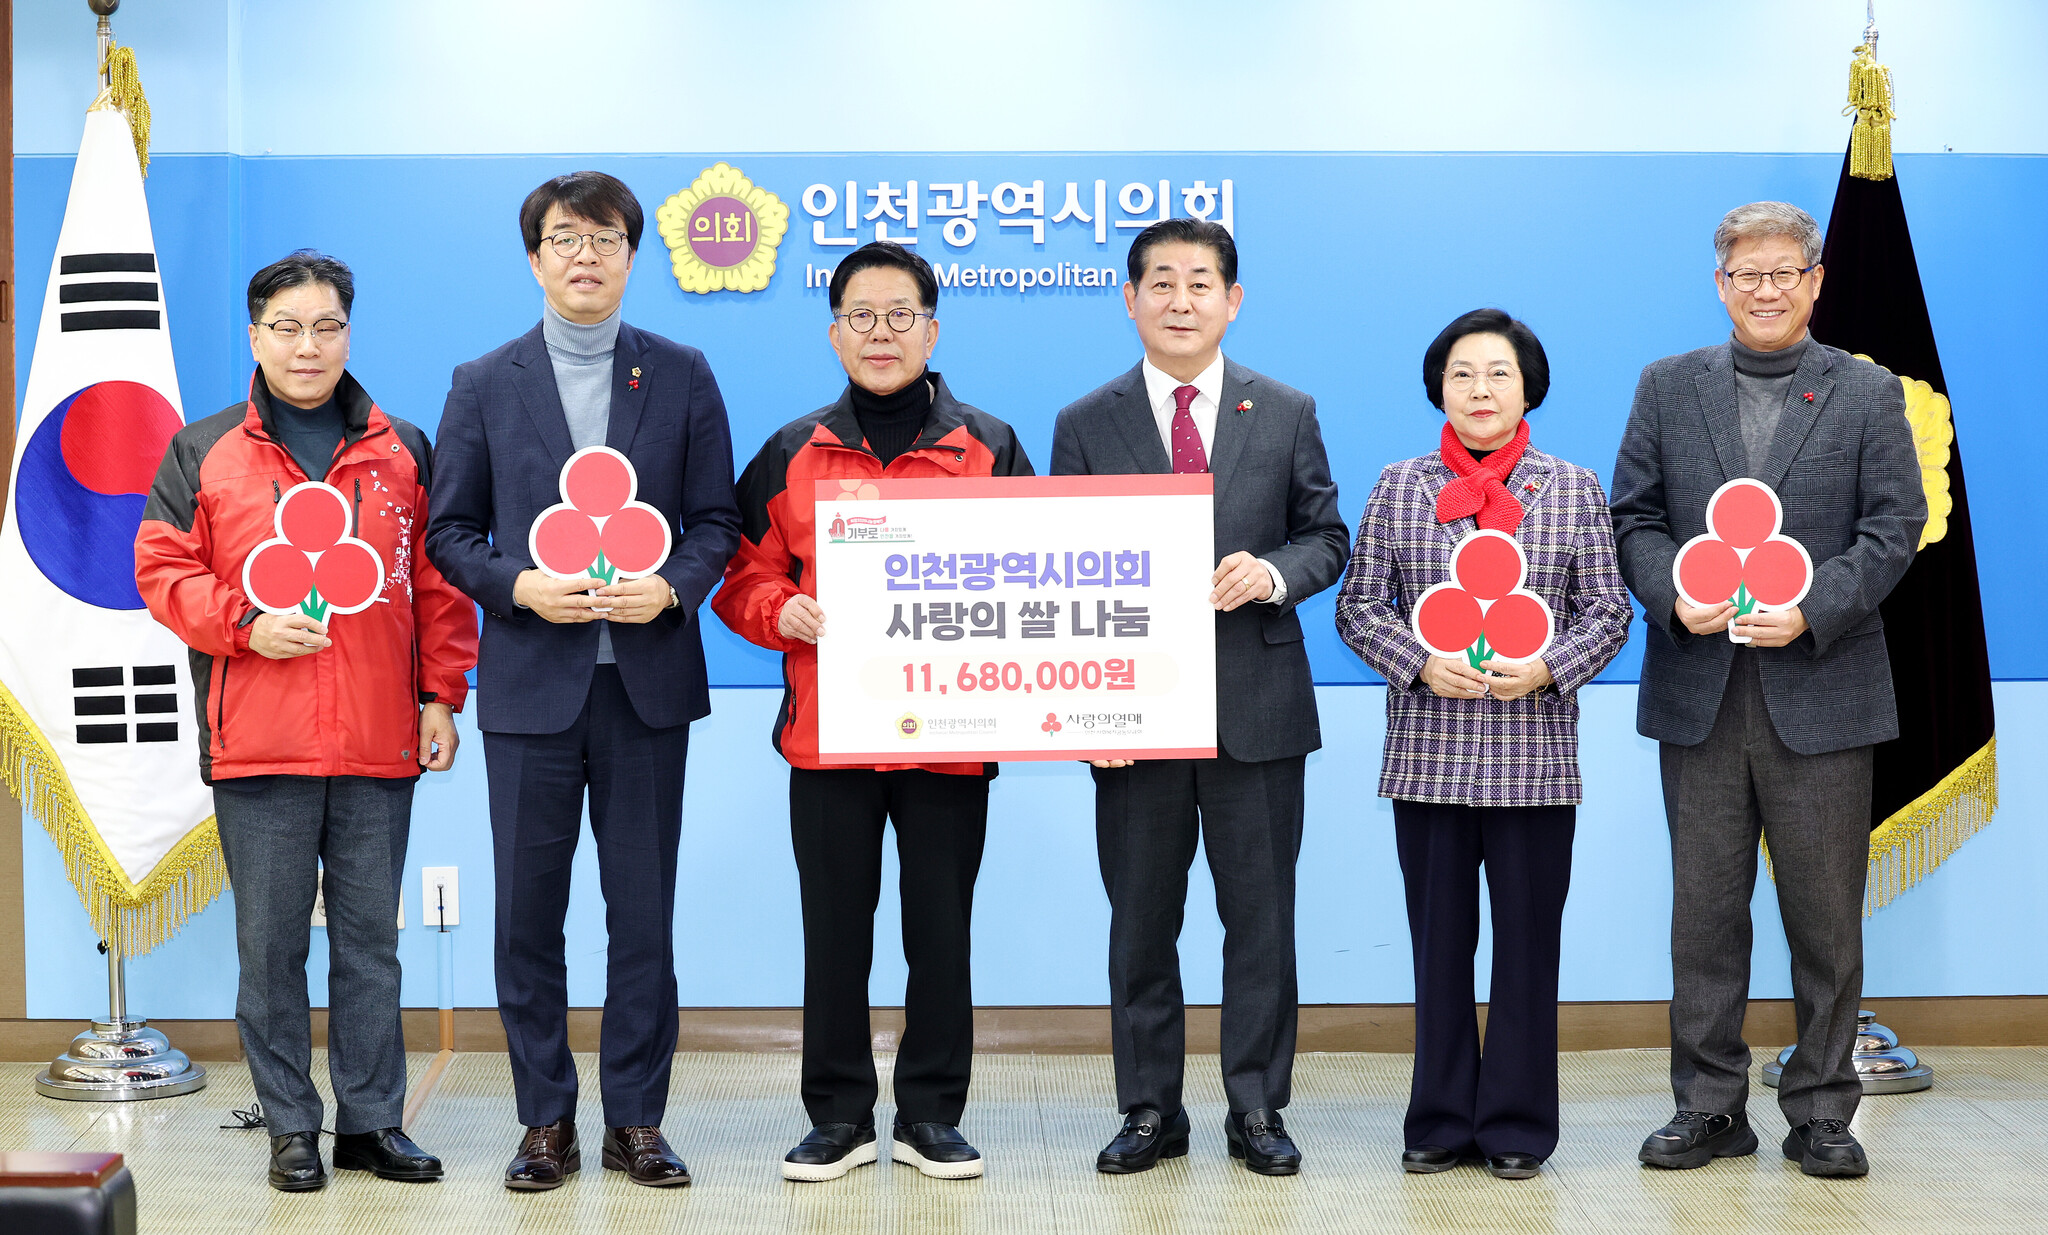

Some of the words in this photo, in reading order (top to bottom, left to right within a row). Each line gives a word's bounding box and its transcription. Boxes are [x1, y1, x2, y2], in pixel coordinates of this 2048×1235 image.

[691, 209, 752, 243] 의회
[802, 179, 1234, 247] 인천광역시의회
[933, 262, 1117, 292] Metropolitan
[847, 527, 879, 540] 기부로
[884, 550, 1151, 591] 인천광역시의회
[886, 601, 1006, 641] 사랑의
[1017, 601, 1060, 638] 쌀
[1071, 600, 1151, 638] 나눔
[927, 718, 997, 729] 인천광역시의회
[1066, 713, 1142, 729] 사랑의열매
